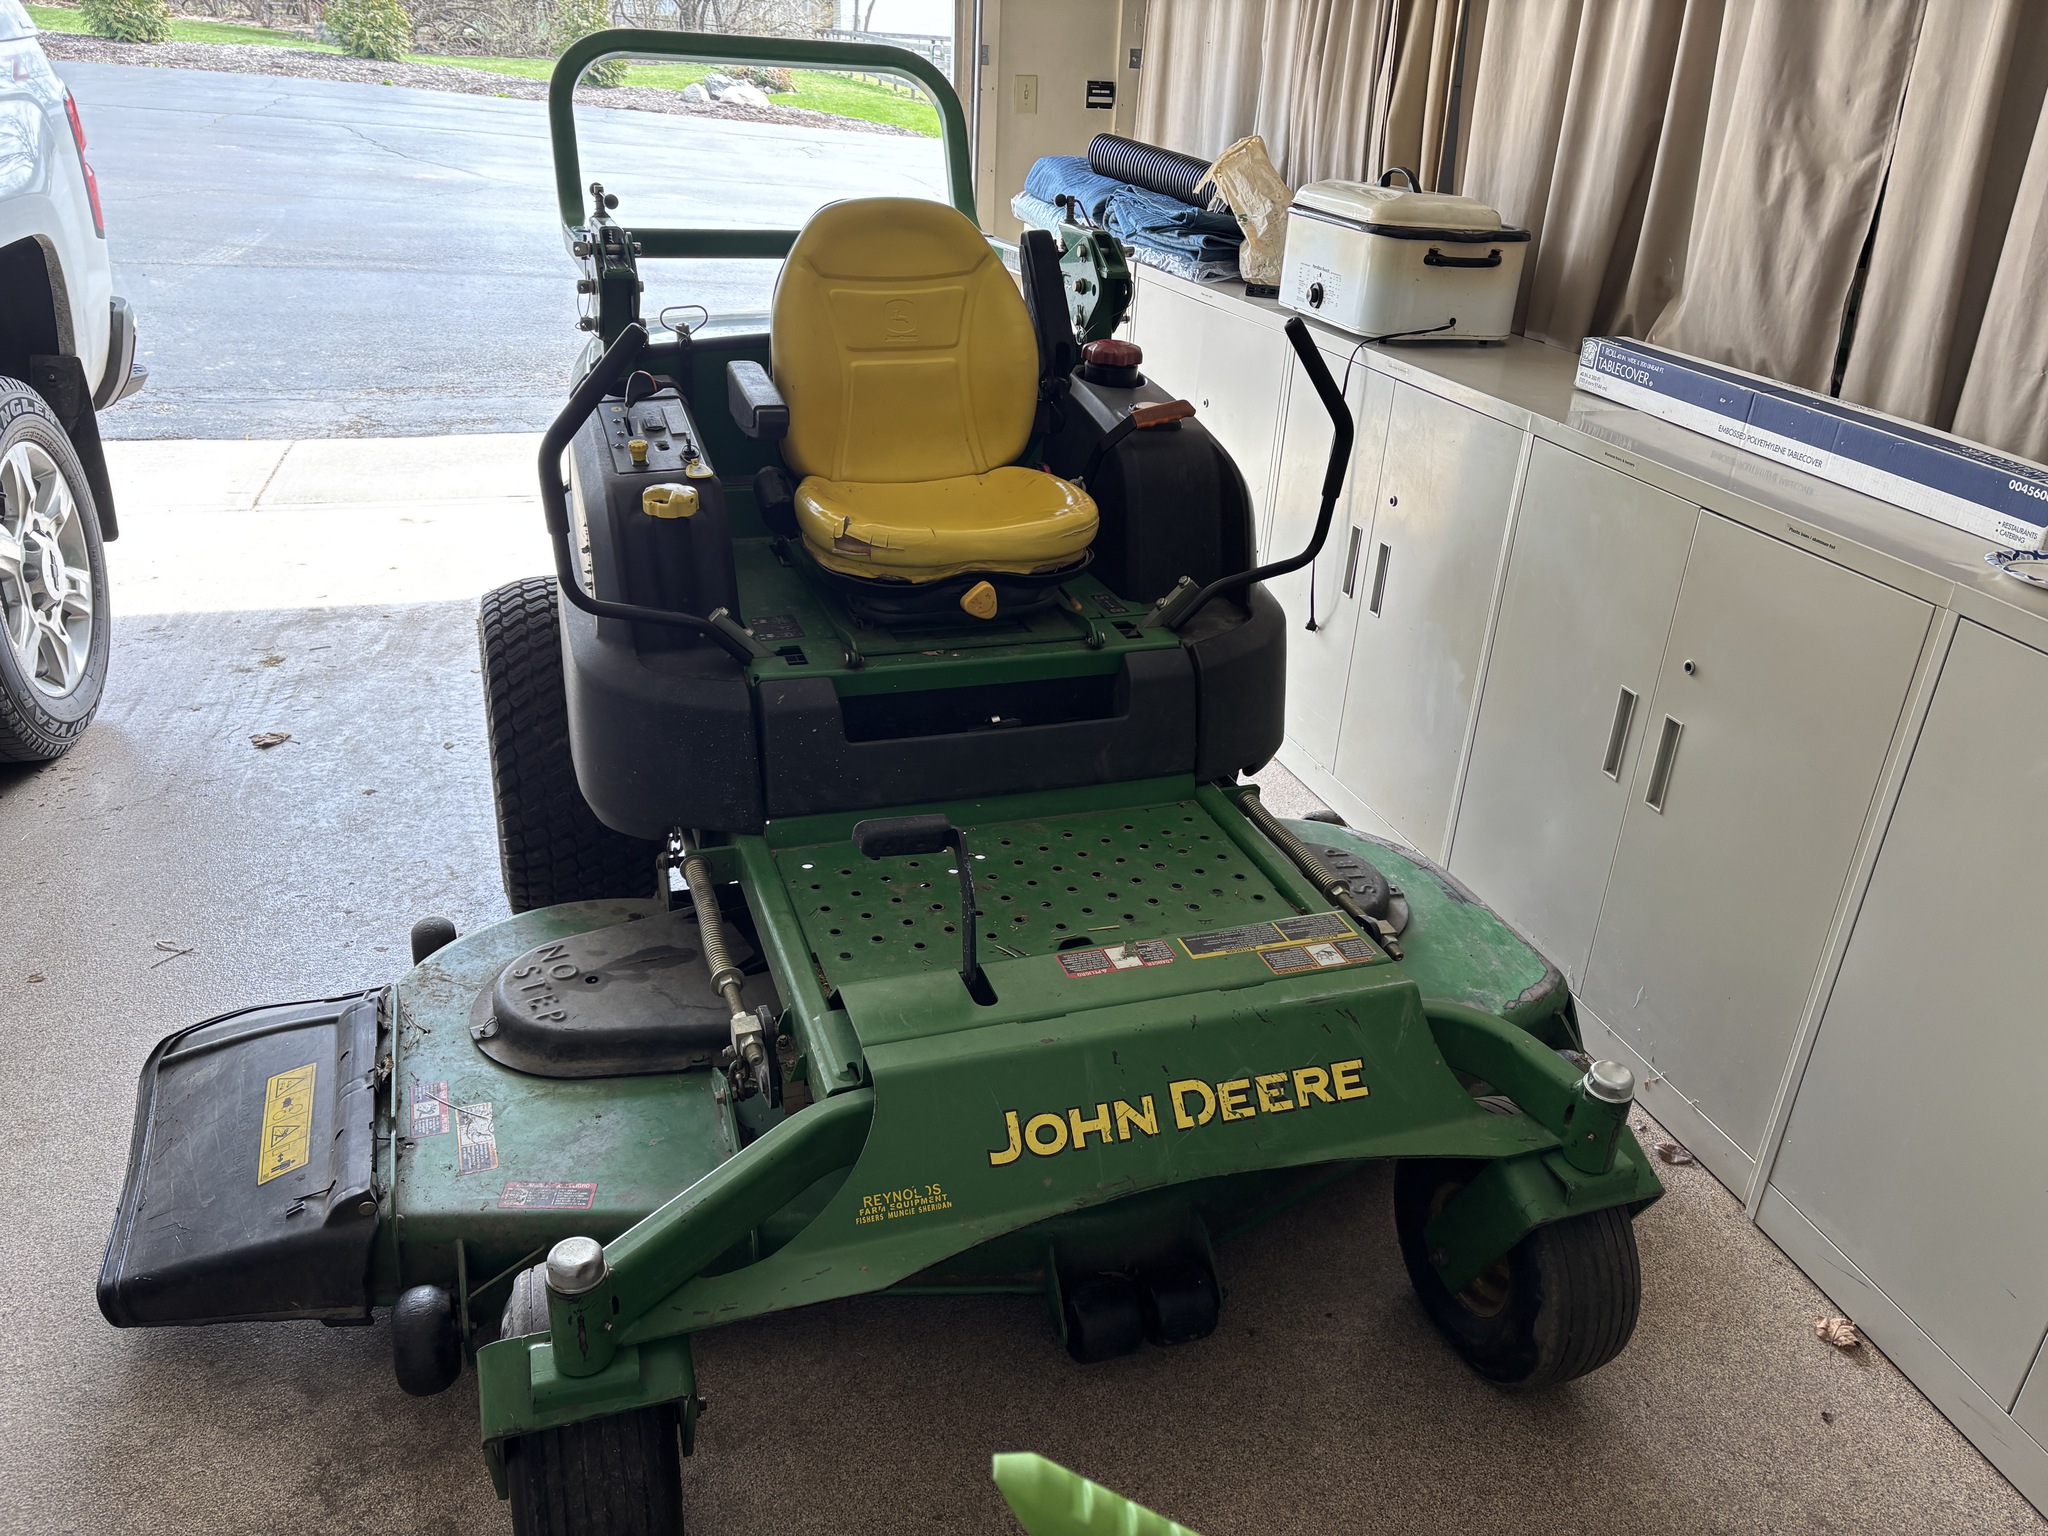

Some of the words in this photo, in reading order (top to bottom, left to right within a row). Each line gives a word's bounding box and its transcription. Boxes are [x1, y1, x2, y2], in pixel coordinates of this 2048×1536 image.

[1604, 347, 1618, 359] ROLL
[1627, 356, 1637, 365] WIDE
[1598, 356, 1650, 386] TABLECOVER
[0, 398, 57, 434] NGLER
[1717, 424, 1747, 441] EMBOSSED
[1746, 434, 1787, 456] POLYETHYLENE
[1787, 448, 1823, 469] TABLECOVER
[2008, 480, 2048, 502] 004560
[1999, 529, 2026, 544] CATERING
[2002, 521, 2039, 540] RESTAURANTS
[536, 944, 580, 982] NO
[512, 964, 567, 1022] STEP
[986, 1093, 1162, 1168] JOHN
[1166, 1056, 1371, 1133] DEERE
[855, 1213, 884, 1225] FISHERS
[887, 1207, 916, 1220] MUNCIE
[918, 1201, 953, 1214] SHERIDAN
[889, 1193, 948, 1211] EQUIPMENT
